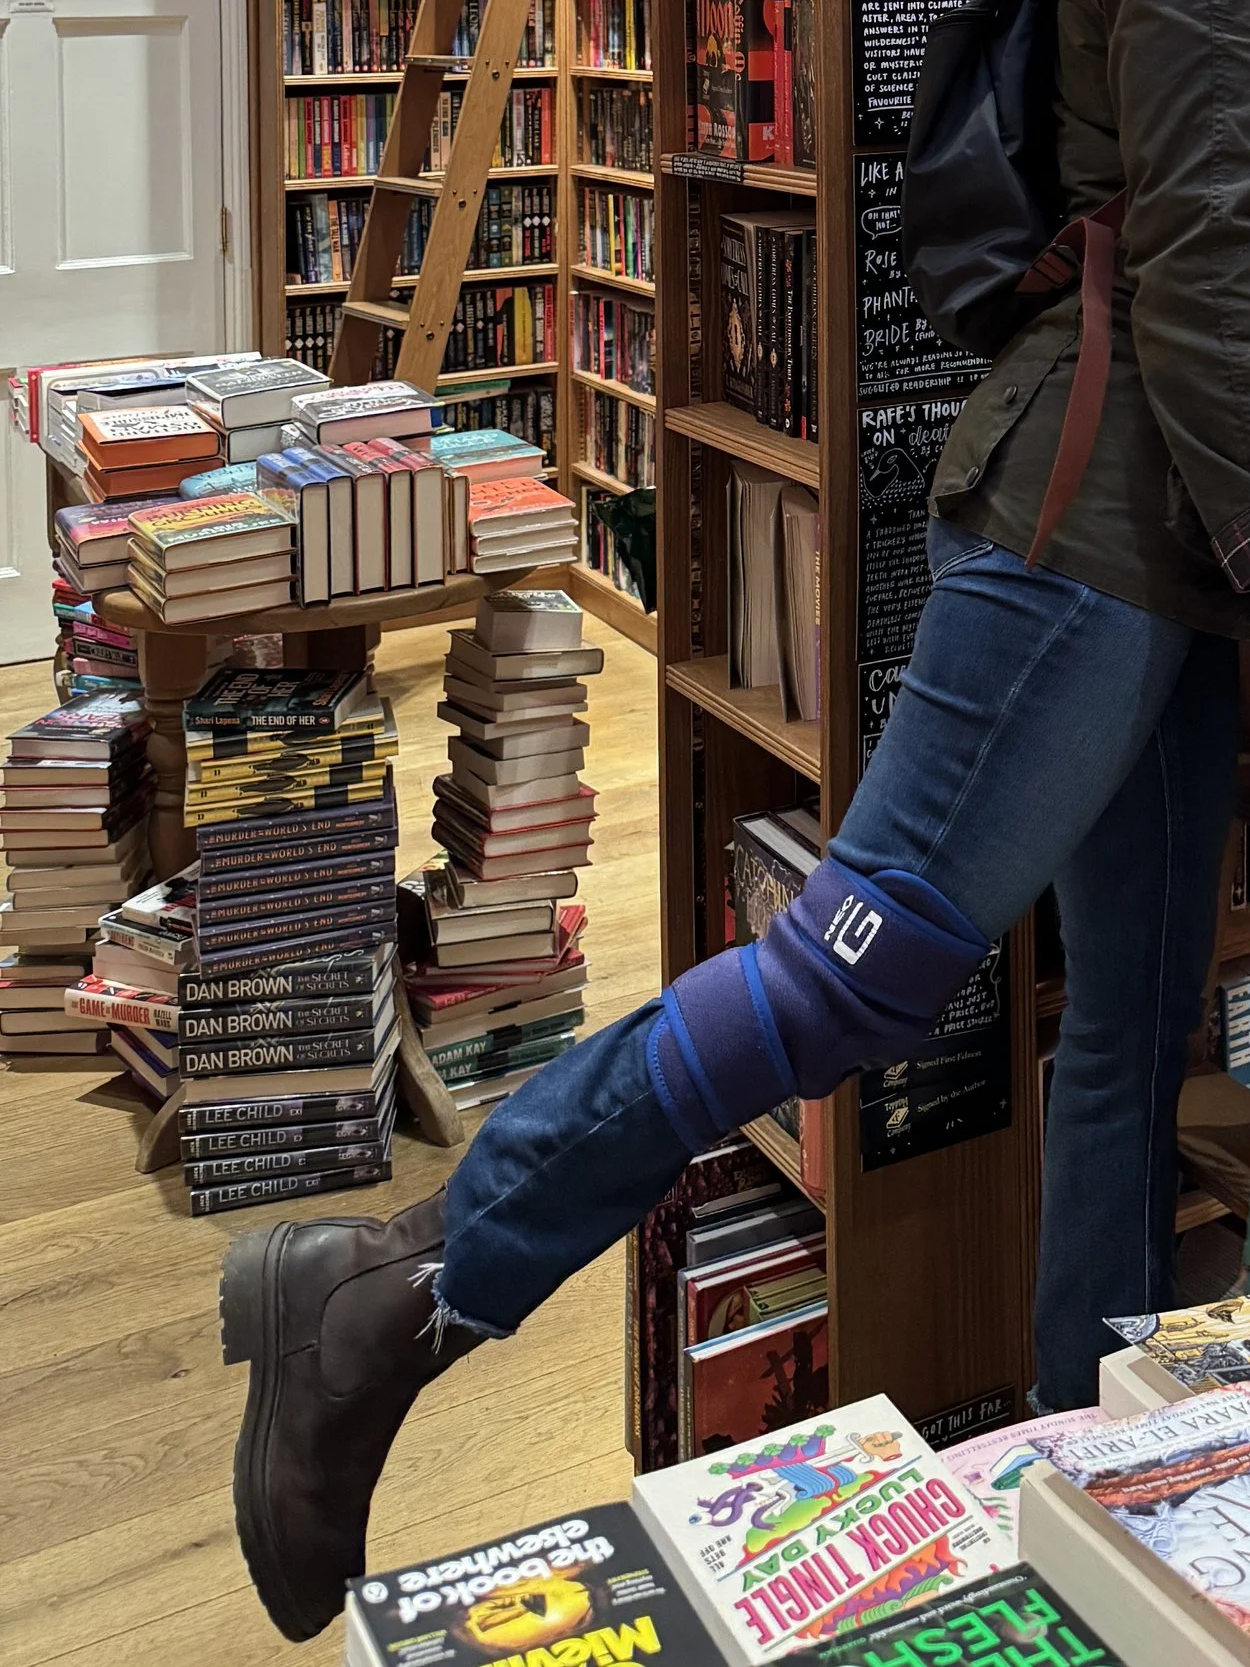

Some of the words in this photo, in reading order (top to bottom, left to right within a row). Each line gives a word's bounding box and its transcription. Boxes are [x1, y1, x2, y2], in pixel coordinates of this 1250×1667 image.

[861, 405, 917, 430] RAFE'S
[251, 716, 267, 725] THE
[268, 716, 285, 725] END
[286, 716, 297, 725] OF
[299, 715, 315, 725] HER
[824, 895, 854, 941] NEO
[186, 982, 223, 1001] DAN
[228, 976, 292, 998] BROWN
[111, 1003, 150, 1025] MURDER
[205, 1108, 234, 1124] LEE
[236, 1105, 282, 1121] CHILD
[948, 1407, 972, 1432] THIS
[1068, 1427, 1177, 1461] EL-ARIFI
[815, 1466, 925, 1547] LUCKY
[845, 1478, 967, 1571] CHUCK
[398, 1519, 590, 1592] elsewhere
[548, 1536, 615, 1567] the
[442, 1557, 550, 1606] book
[741, 1546, 810, 1592] DAY
[398, 1590, 442, 1624] of
[734, 1543, 866, 1645] TINGLE
